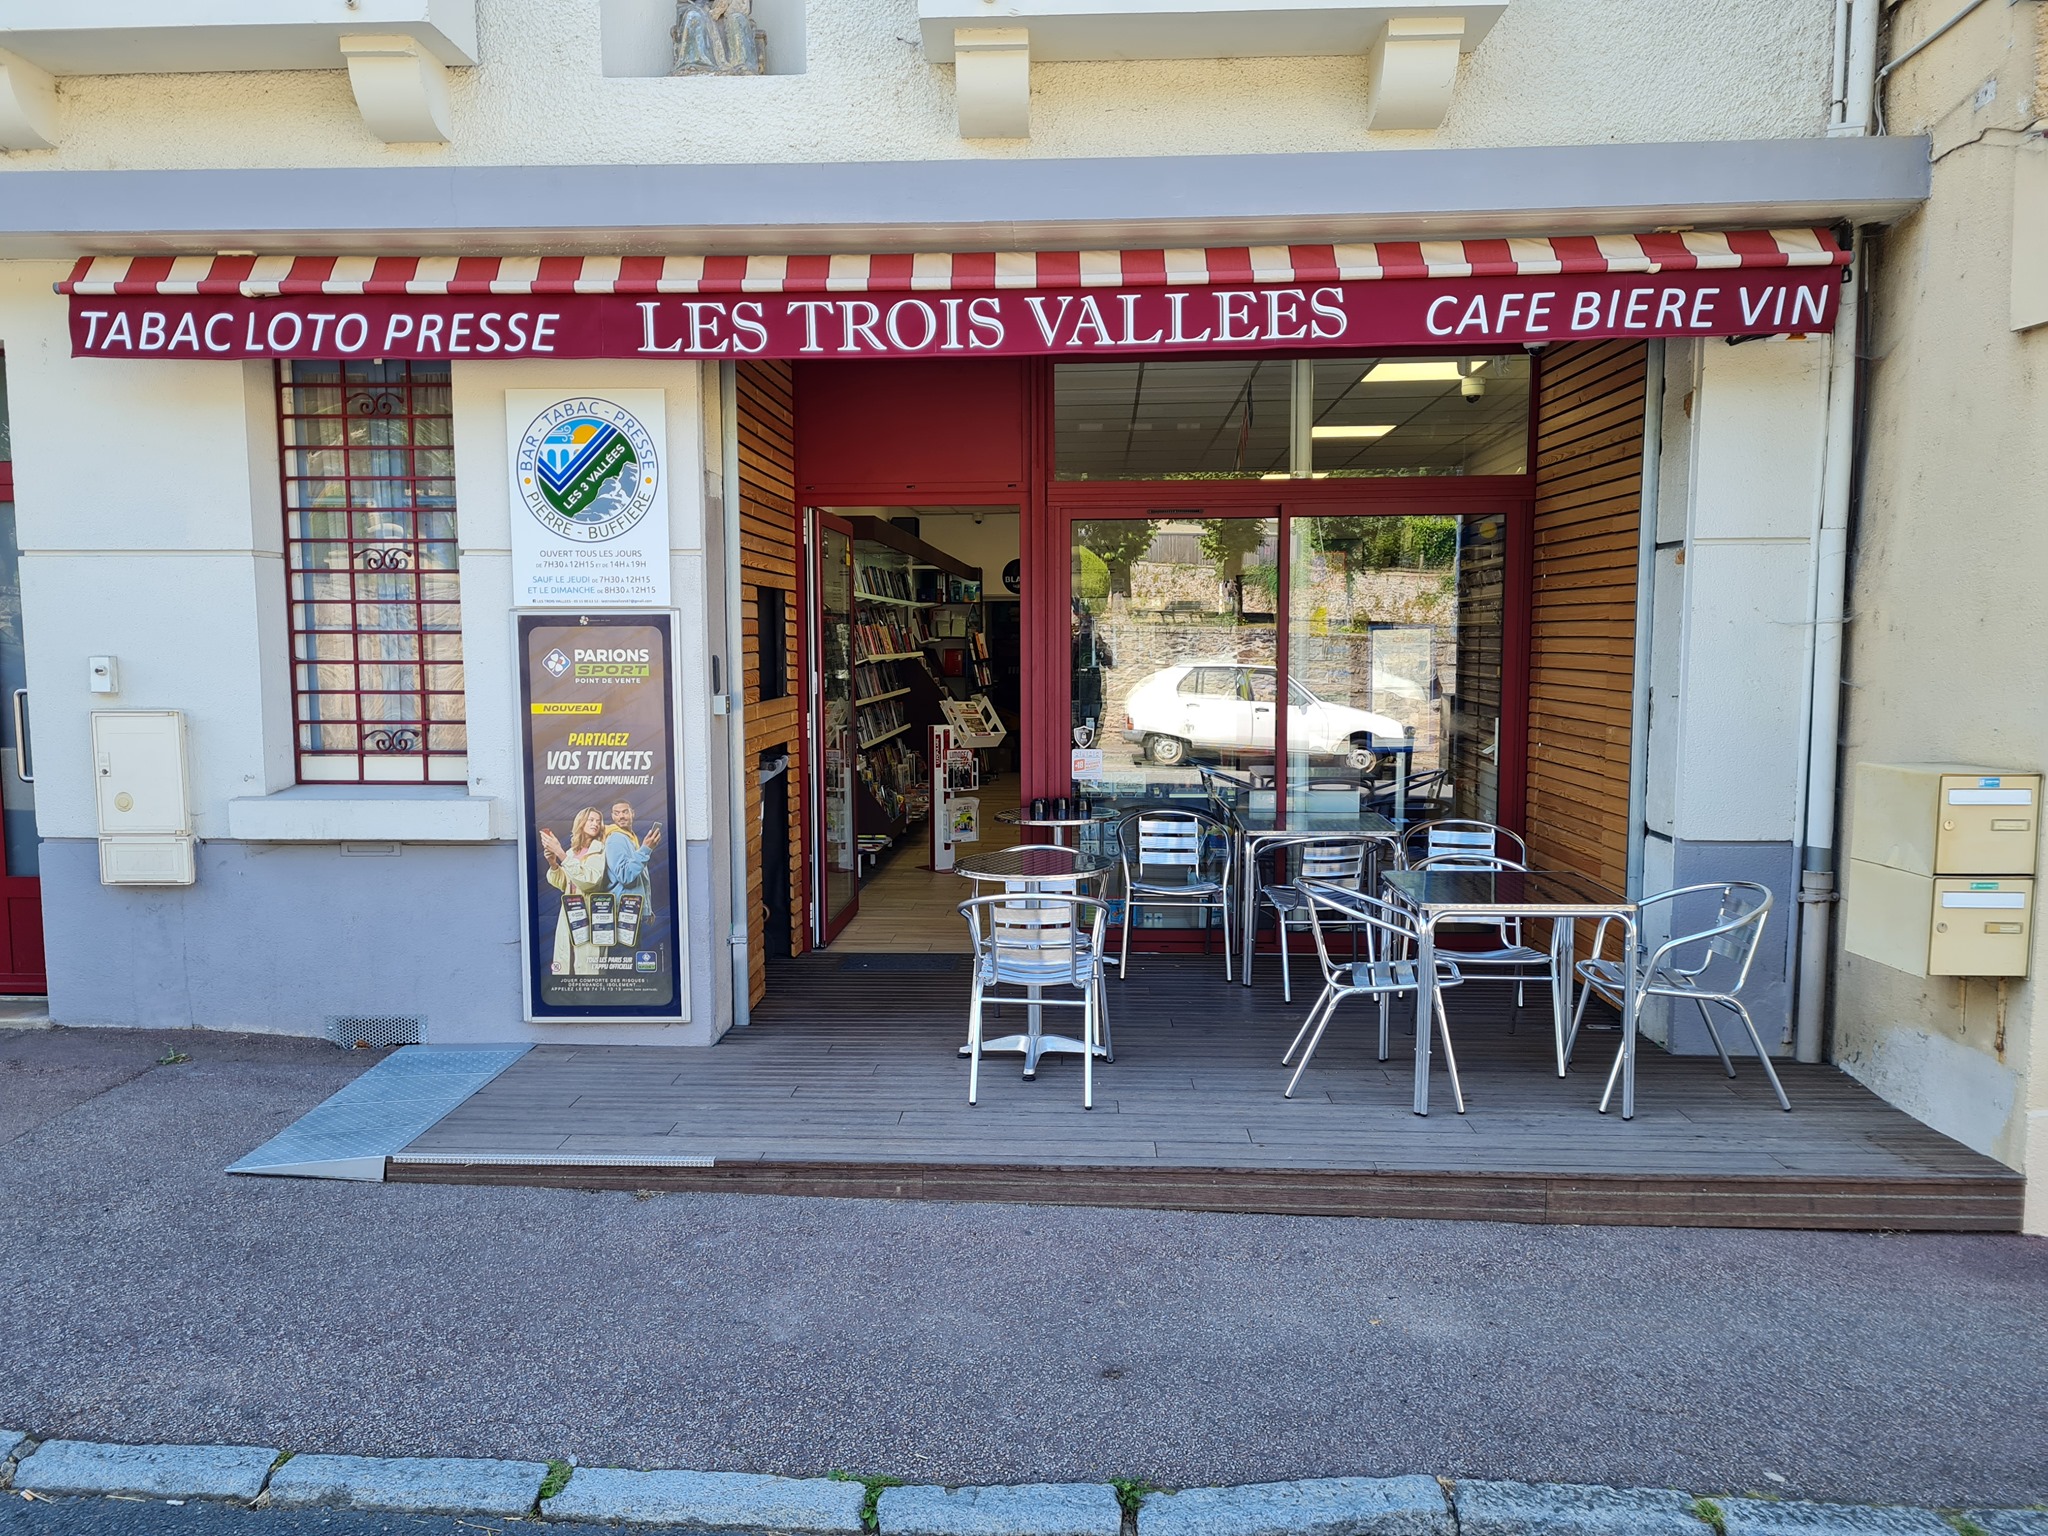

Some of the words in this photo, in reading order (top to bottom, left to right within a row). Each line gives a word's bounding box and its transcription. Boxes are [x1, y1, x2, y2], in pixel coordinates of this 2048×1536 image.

[637, 301, 768, 353] LES
[786, 297, 1006, 352] TROIS
[1024, 286, 1349, 348] VALLEES
[1425, 291, 1557, 336] CAFE
[1570, 286, 1722, 331] BIERE
[1738, 283, 1831, 326] VIN
[80, 310, 234, 353] TABAC
[245, 311, 370, 354] LOTO
[382, 312, 561, 354] PRESSE
[520, 436, 540, 471] BAR
[542, 401, 599, 426] TABAC
[614, 411, 655, 470] PRESSE
[562, 489, 583, 510] LES
[580, 481, 590, 492] 3
[585, 442, 627, 483] VALLÉES
[527, 491, 573, 535] PIERRE
[588, 491, 651, 539] BUFFIERE
[540, 550, 573, 558] OUVERT
[575, 550, 598, 558] TOUS
[599, 550, 613, 558] LES
[615, 550, 643, 558] JOURS
[574, 649, 650, 662] PARIONS
[577, 665, 648, 675] SPORT
[568, 733, 630, 746] PARTAGEZ
[547, 751, 582, 770] VOS
[587, 751, 653, 770] TICKETS
[544, 775, 566, 785] AVEC
[567, 775, 592, 785] VOTRE
[594, 774, 649, 785] COMMUNAUTÉ
